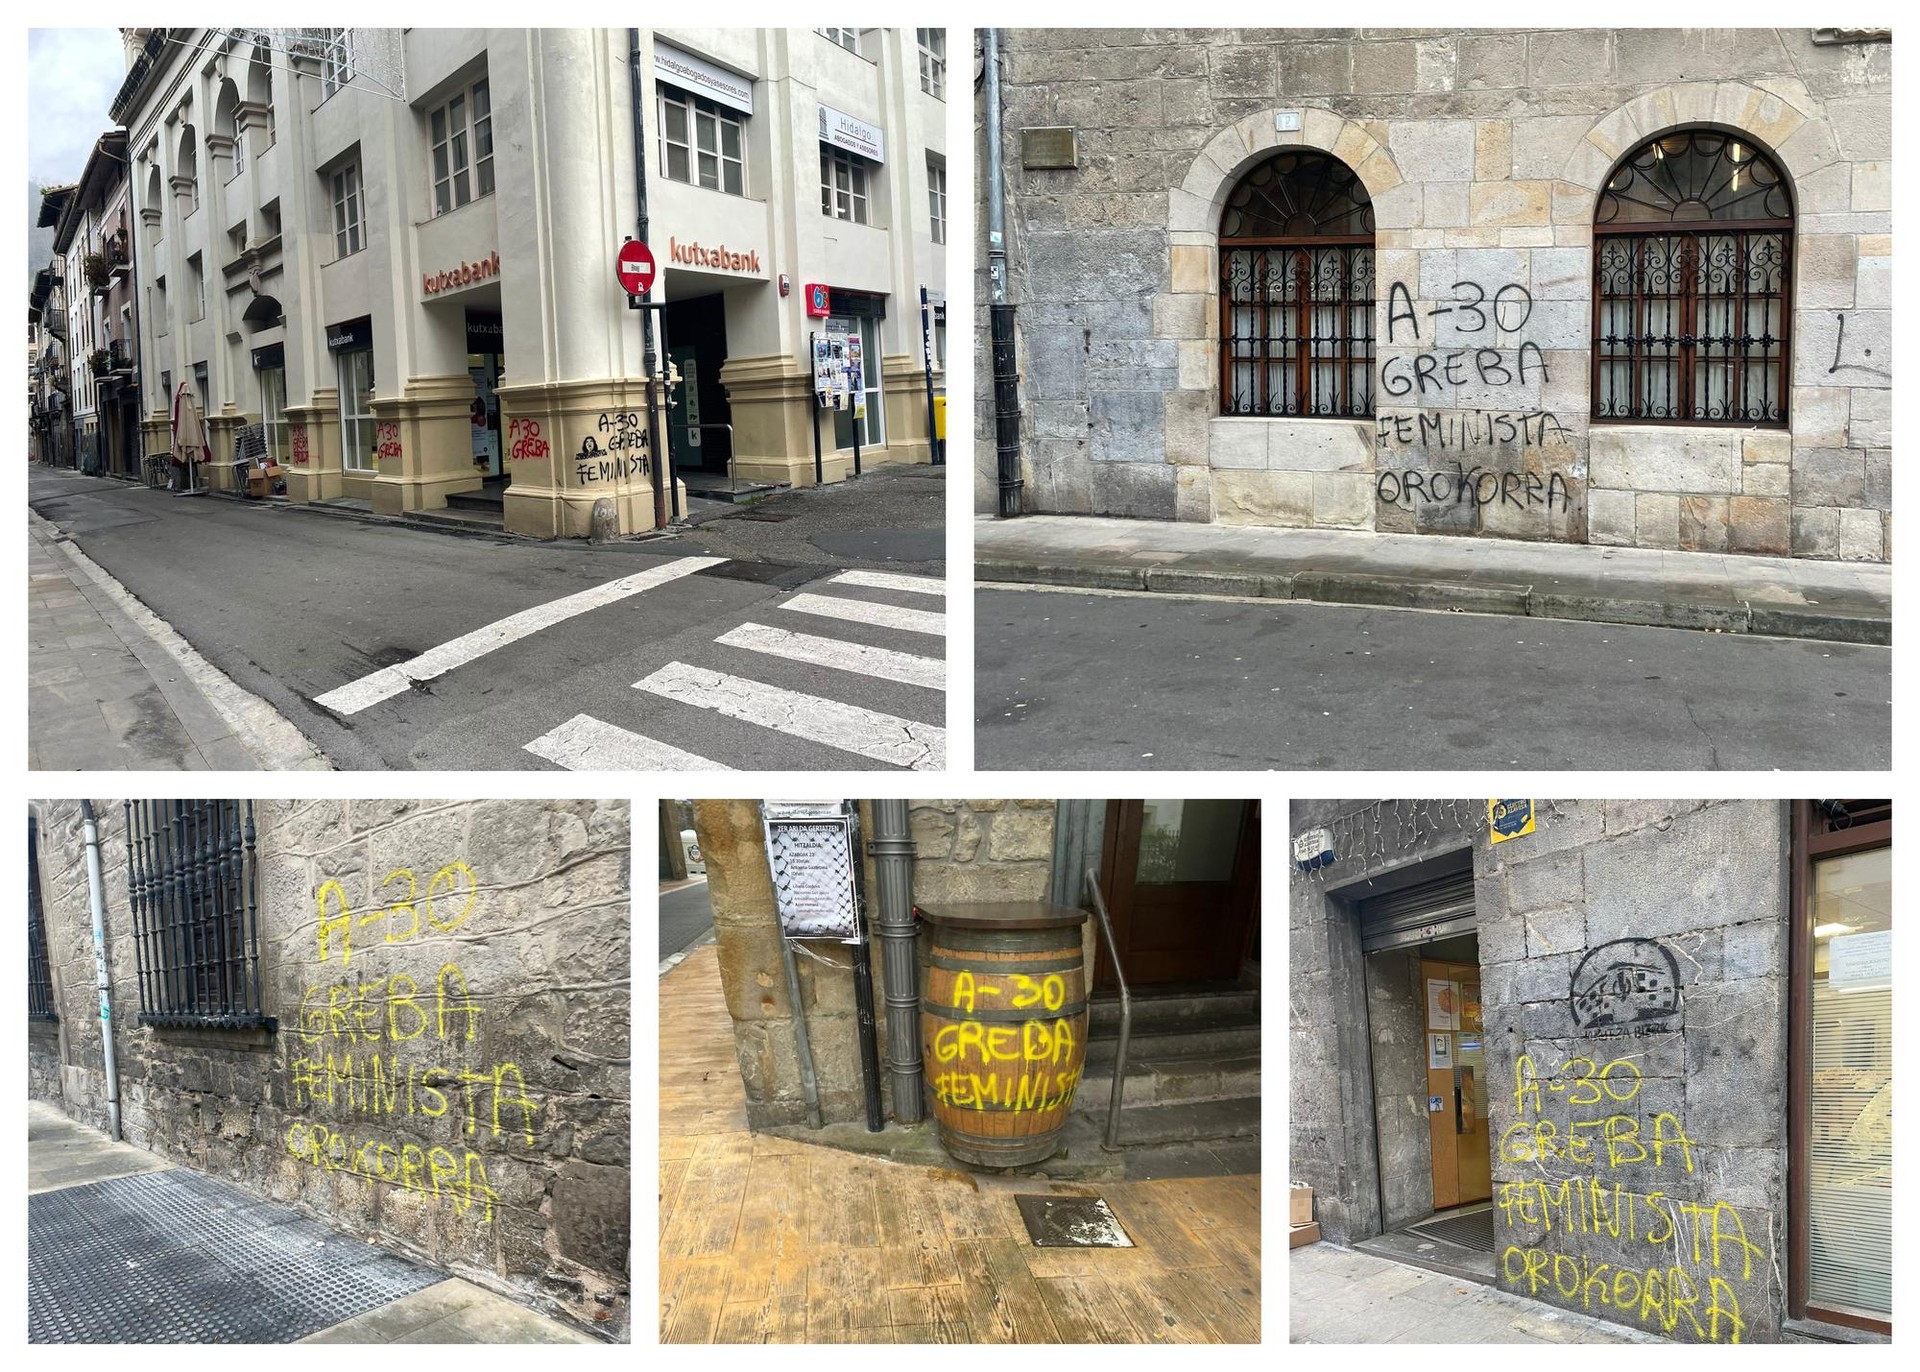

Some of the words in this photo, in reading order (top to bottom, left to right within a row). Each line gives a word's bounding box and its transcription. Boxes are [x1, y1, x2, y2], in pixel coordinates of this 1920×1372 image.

[834, 134, 856, 148] ABOGADOS
[859, 145, 879, 157] ASESORES
[840, 117, 872, 141] Hidalgo
[423, 250, 500, 294] kutxabank
[670, 236, 761, 273] kutxabank
[1389, 281, 1532, 343] A-30
[328, 333, 355, 346] kutxabank
[1382, 341, 1549, 396] GREBA
[377, 422, 398, 440] A30
[509, 418, 540, 439] A30
[598, 413, 638, 433] A-30
[608, 428, 649, 451] GREBA
[1378, 411, 1572, 451] FEMINISTA
[377, 441, 403, 459] GREBA
[512, 437, 550, 460] GREBA
[576, 454, 650, 485] FEMINISTA
[1377, 462, 1572, 514] OROKORRA
[317, 860, 477, 966] A-30
[300, 963, 482, 1044] GREBA
[953, 969, 1065, 1013] A-30
[934, 1018, 1076, 1068] GREBA
[291, 1053, 538, 1146] FEMINISTA
[1514, 1054, 1643, 1114] A-30
[1500, 1111, 1699, 1174] GREBA
[287, 1122, 501, 1224] OROKORRA
[1499, 1176, 1766, 1281] FEMINISTA
[1502, 1245, 1747, 1343] OROKORRA
